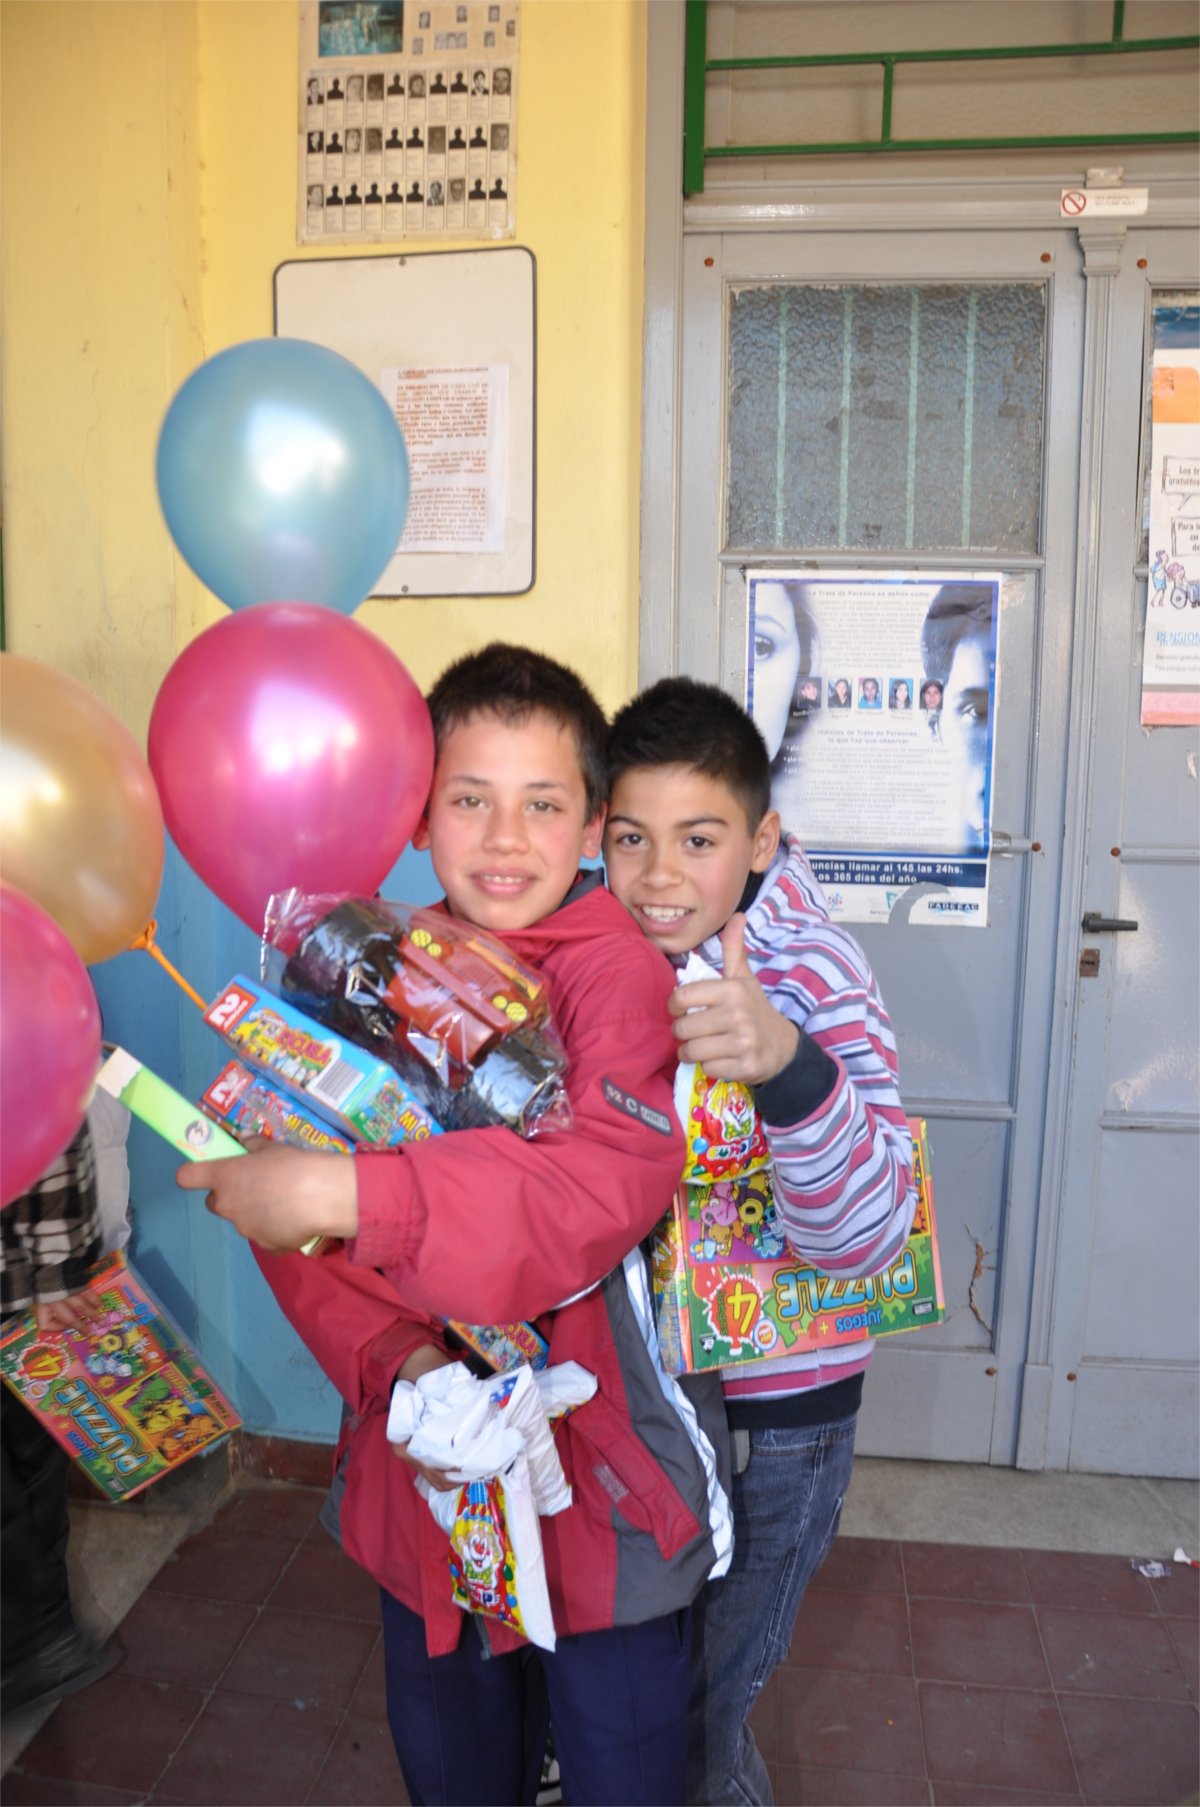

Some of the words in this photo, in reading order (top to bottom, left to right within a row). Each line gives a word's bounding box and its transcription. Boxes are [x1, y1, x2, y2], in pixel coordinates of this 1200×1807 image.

[1177, 522, 1194, 530] Para
[811, 861, 848, 871] uncias
[849, 861, 881, 872] llamar
[884, 863, 893, 872] al
[897, 863, 914, 873] 145
[917, 863, 932, 873] las
[879, 873, 895, 883] del
[285, 1114, 299, 1132] MI
[400, 1110, 417, 1132] MI
[726, 1281, 759, 1335] 4
[835, 1309, 883, 1334] JUEGOS
[54, 1376, 152, 1477] PUZZLE
